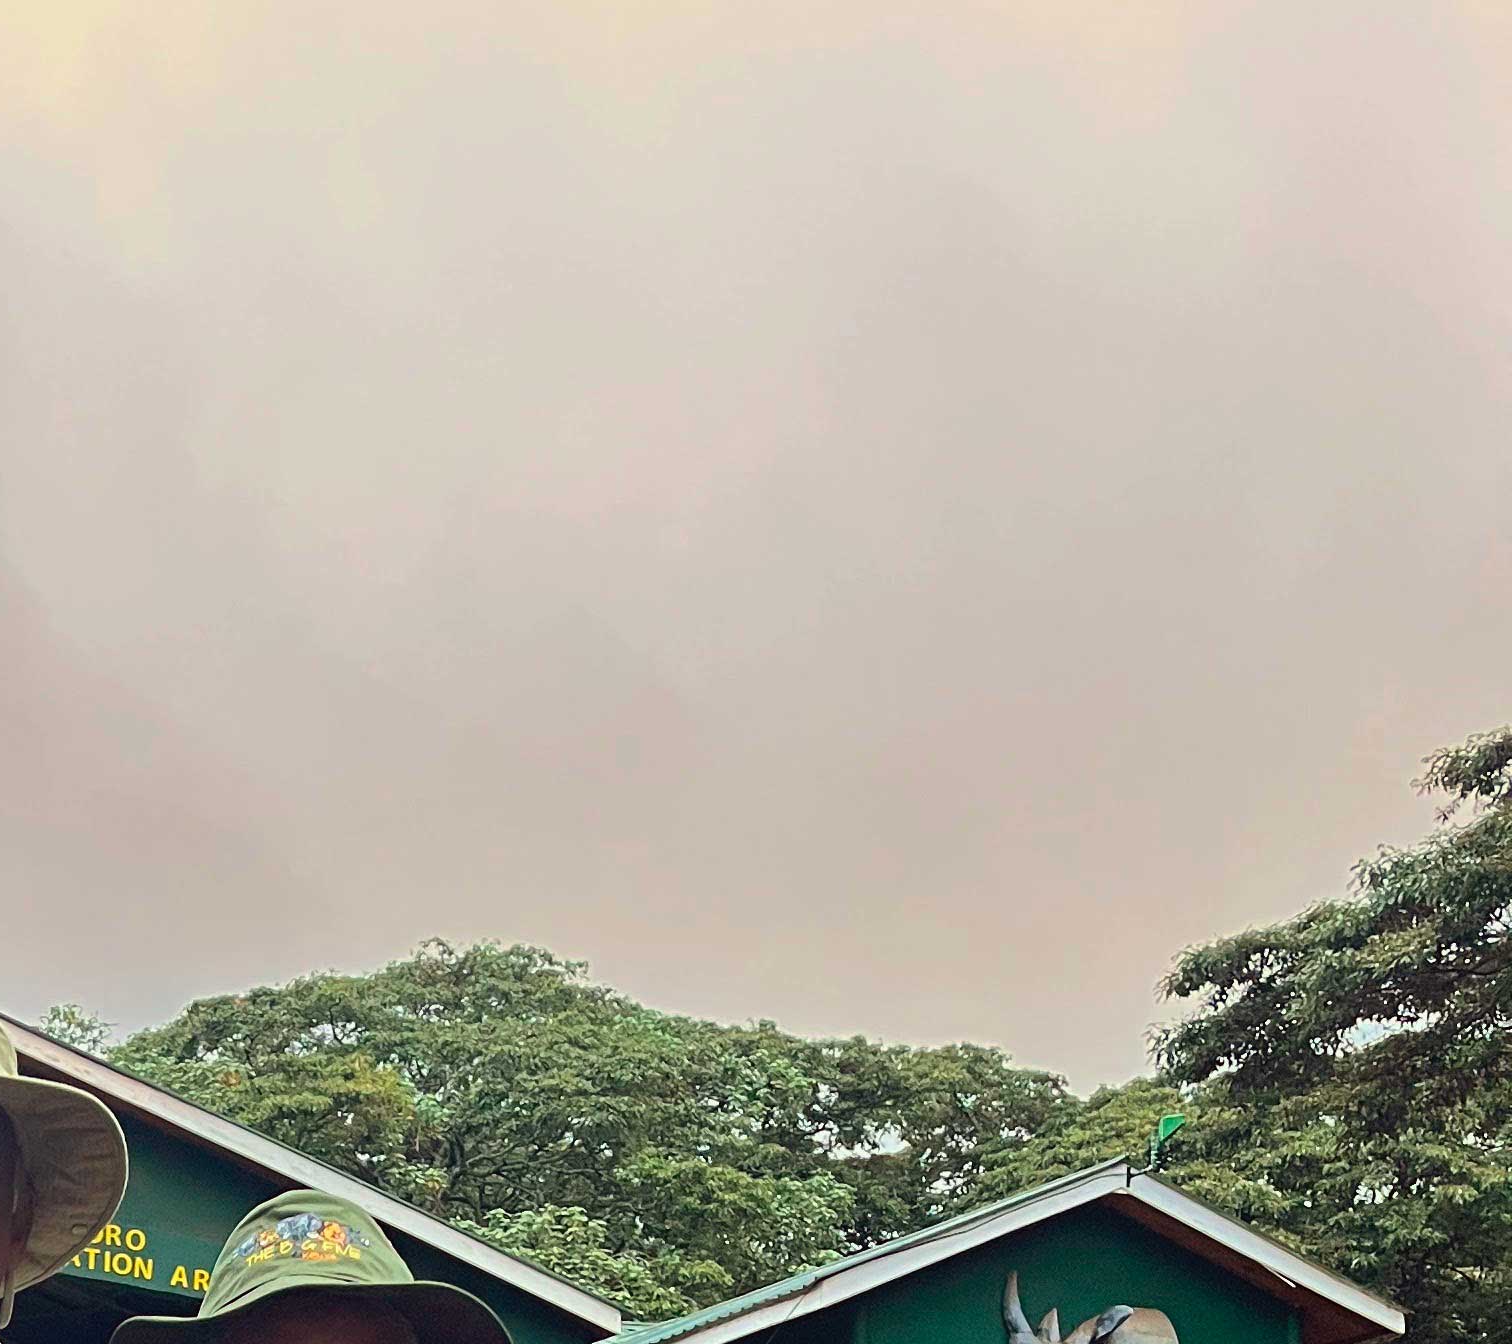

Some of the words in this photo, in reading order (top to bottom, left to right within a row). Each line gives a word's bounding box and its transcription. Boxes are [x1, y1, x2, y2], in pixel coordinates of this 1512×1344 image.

[71, 1247, 154, 1280] TION
[170, 1265, 210, 1291] AR
[246, 1245, 275, 1267] THE
[279, 1239, 317, 1254] BG
